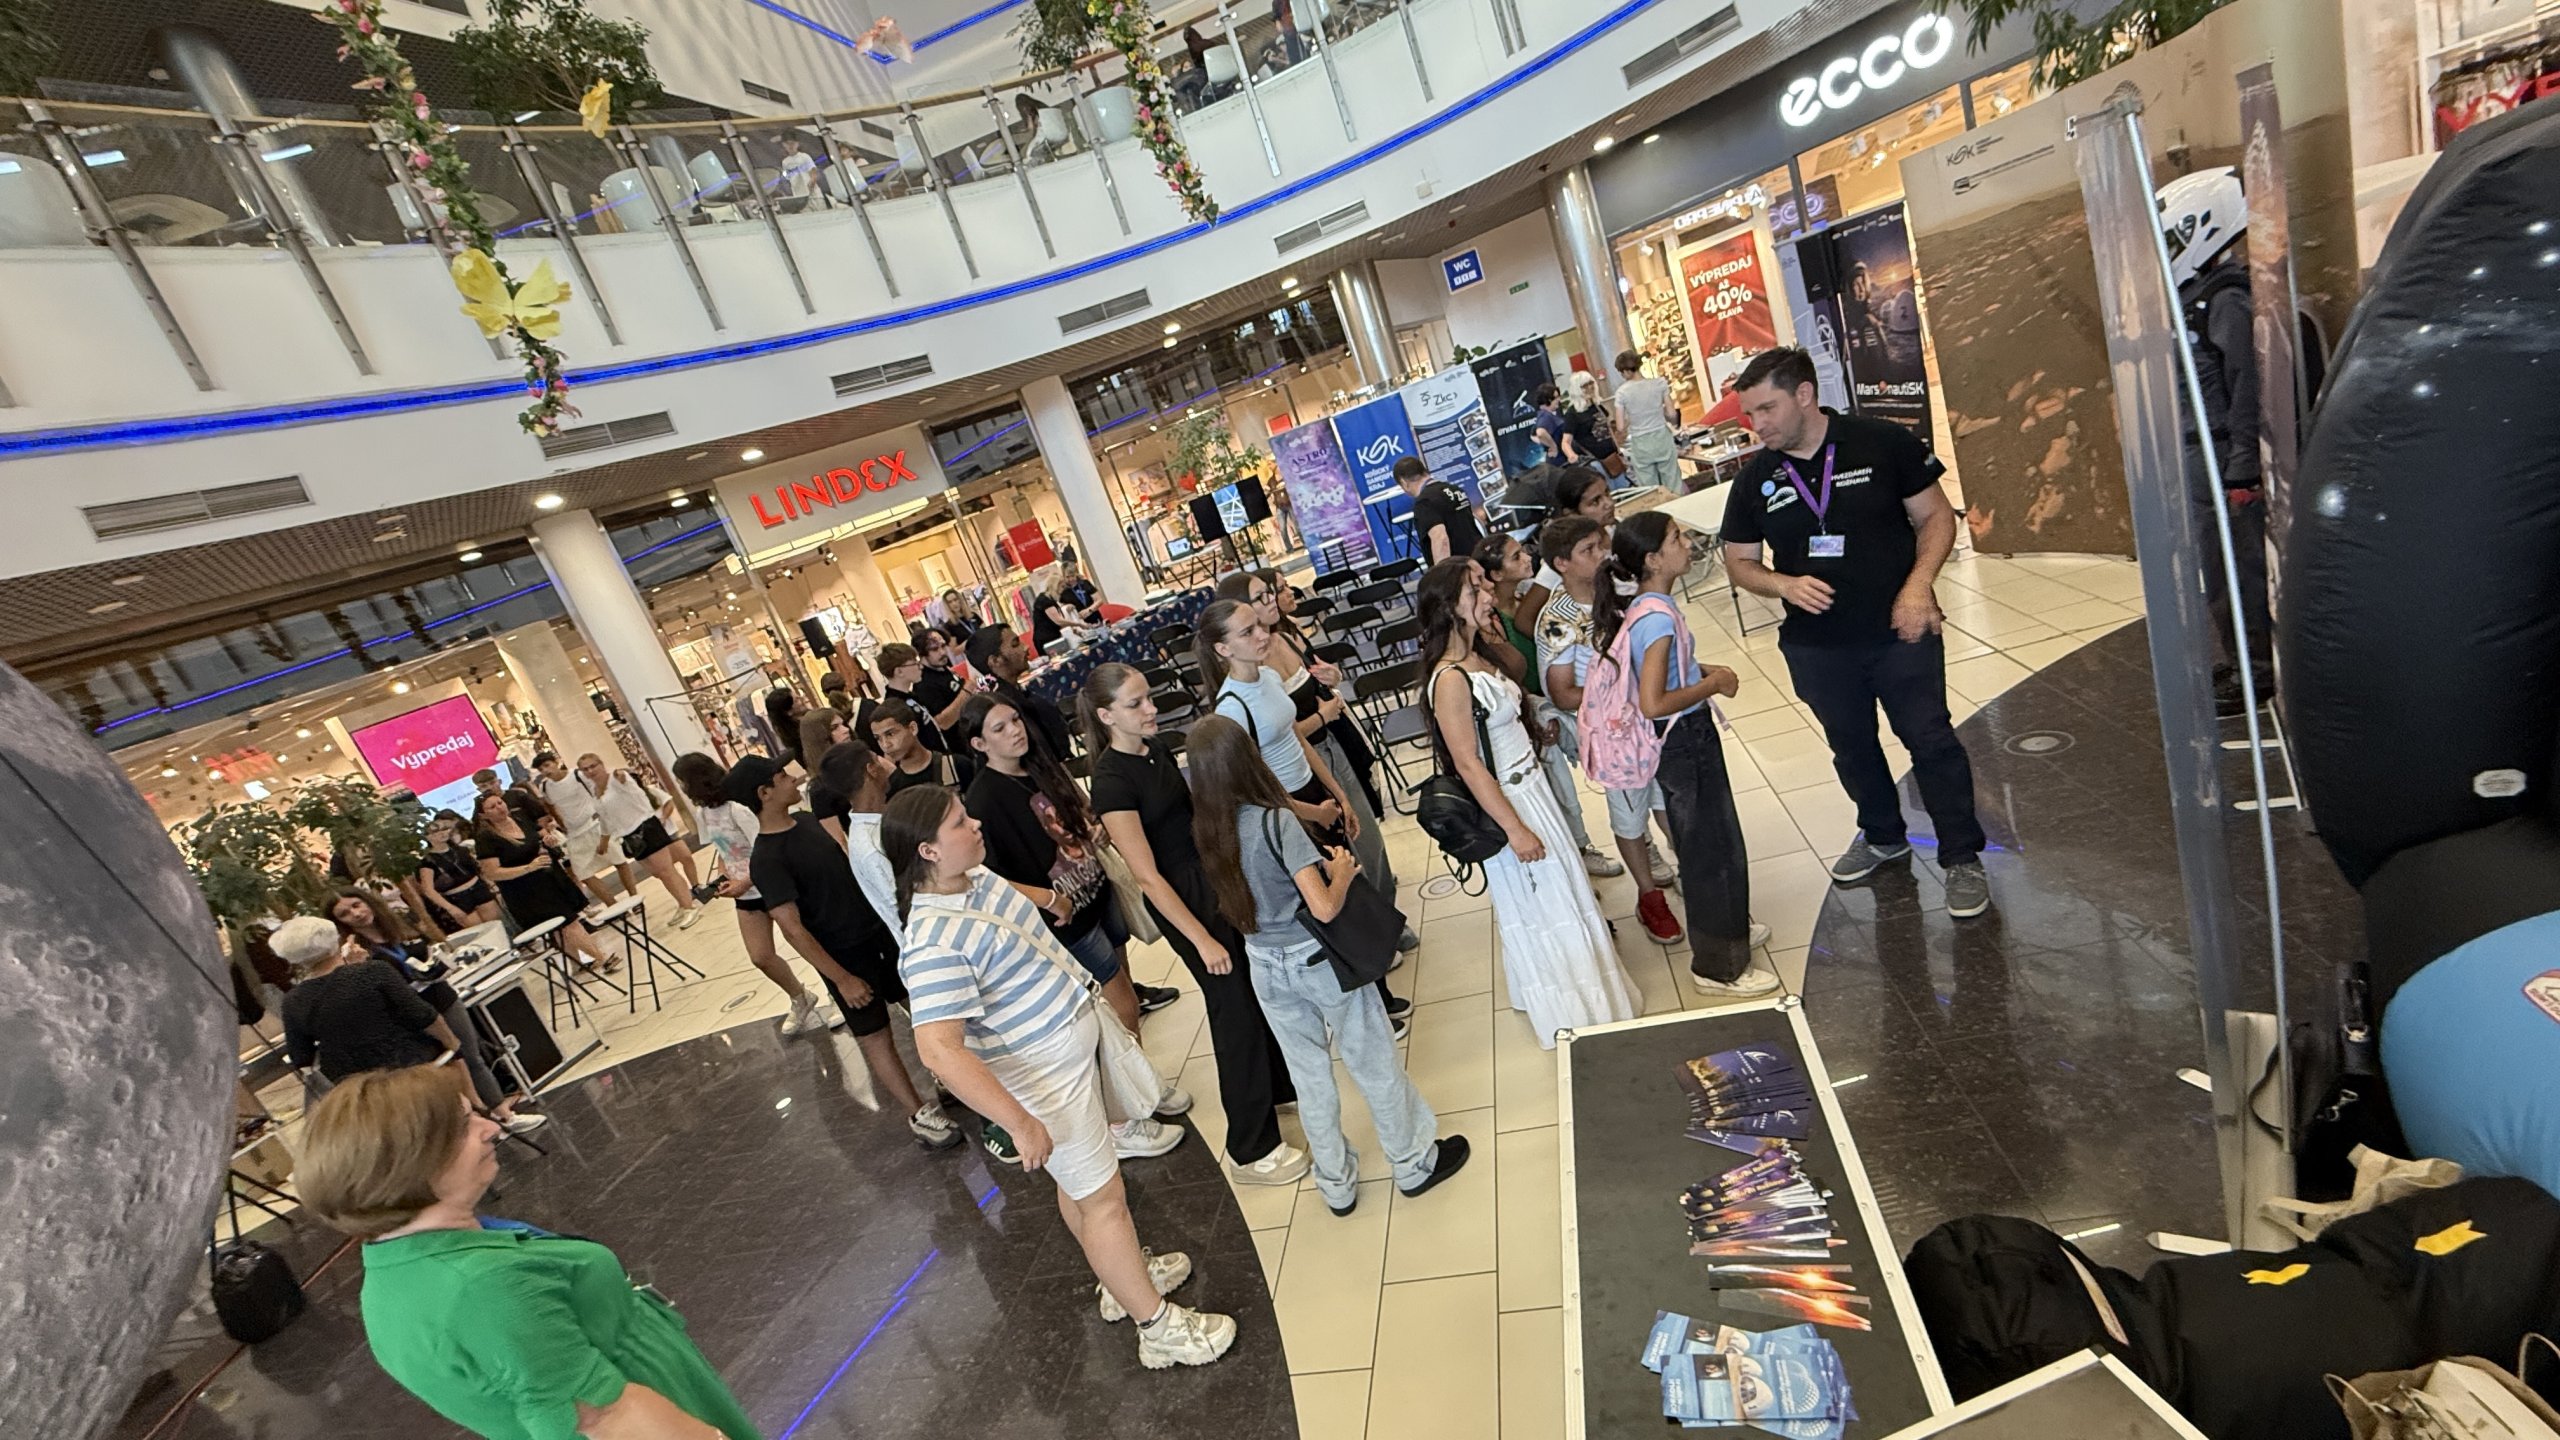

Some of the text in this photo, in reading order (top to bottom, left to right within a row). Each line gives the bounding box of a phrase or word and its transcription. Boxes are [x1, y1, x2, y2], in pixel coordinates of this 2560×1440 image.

[1780, 13, 1954, 126] ecco
[1453, 258, 1471, 272] WC
[1690, 255, 1753, 288] VÝPREDAJ
[1703, 284, 1752, 314] 40%
[1356, 435, 1404, 467] KSK
[749, 450, 918, 529] LINDEX
[390, 731, 475, 770] Výpredaj
